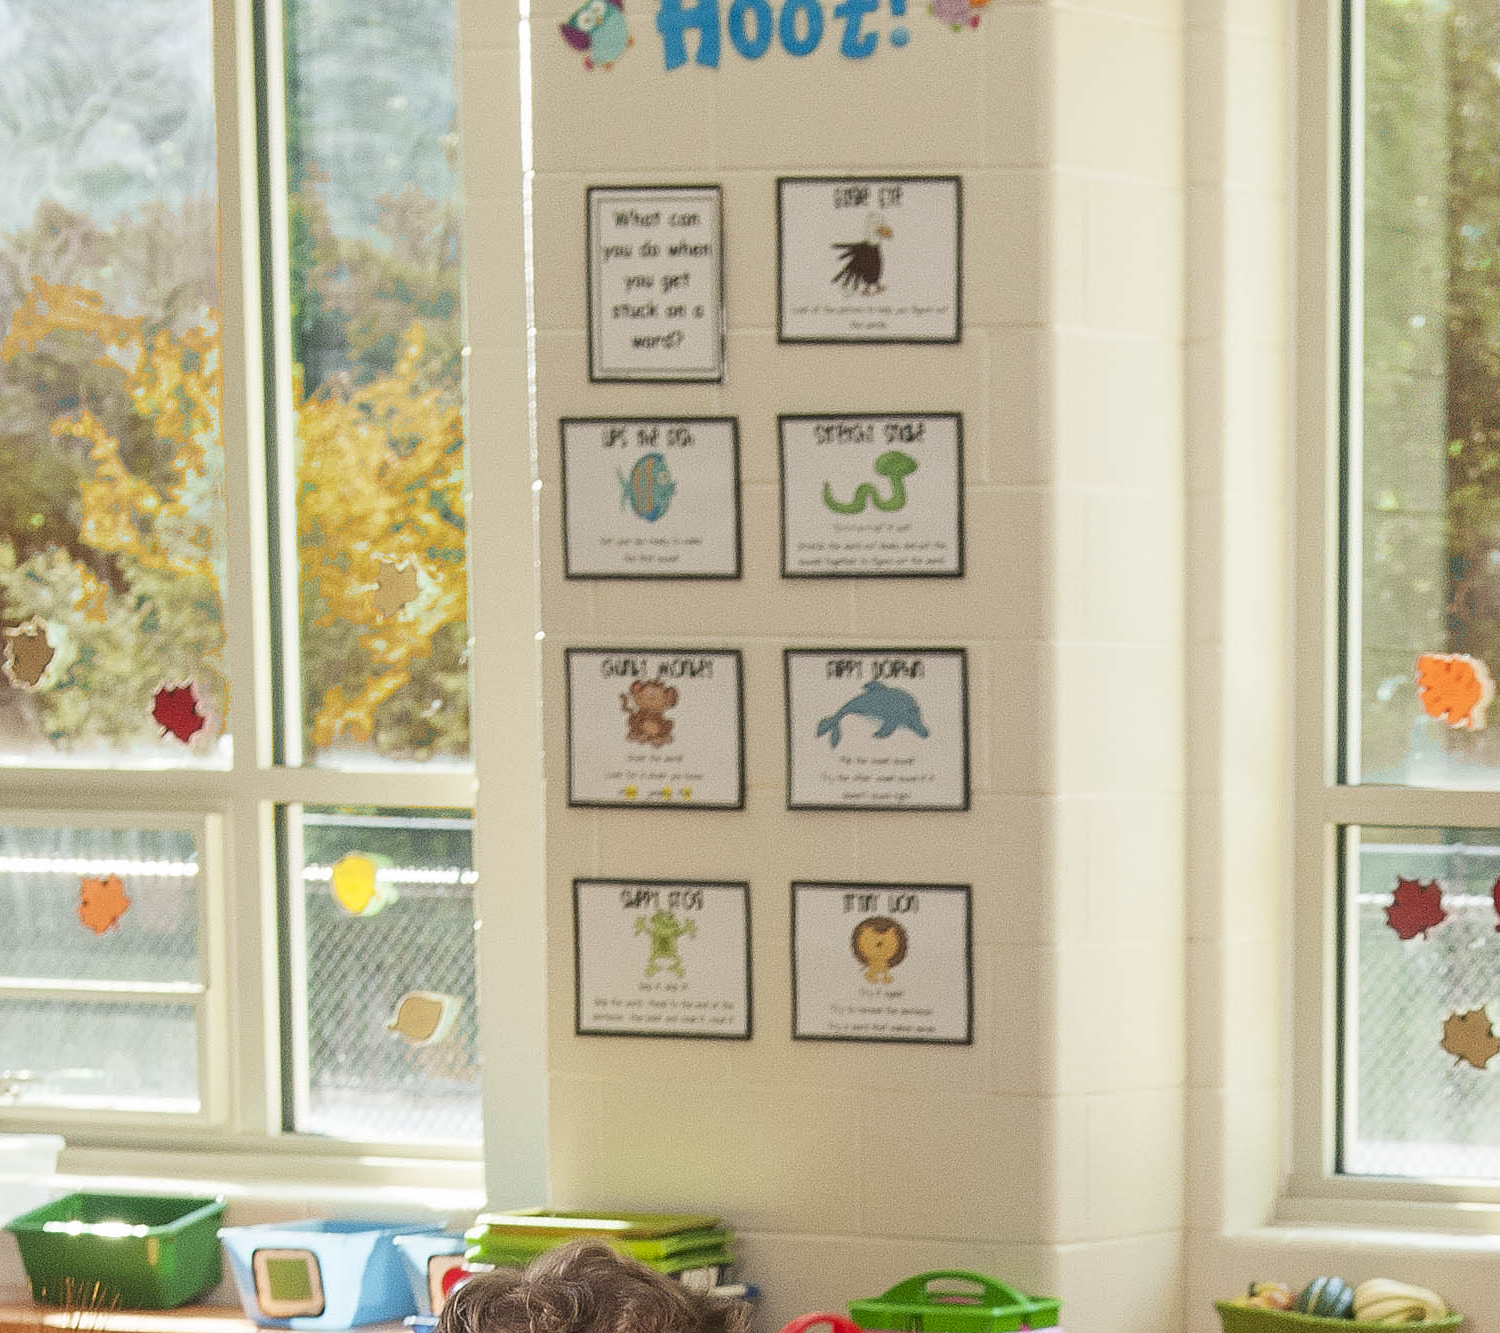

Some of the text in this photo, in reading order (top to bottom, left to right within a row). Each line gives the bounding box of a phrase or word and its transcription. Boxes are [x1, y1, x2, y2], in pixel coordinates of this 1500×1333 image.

[613, 209, 700, 228] What can
[603, 240, 712, 262] you do when
[624, 273, 690, 294] you get
[612, 302, 657, 320] stuck
[664, 305, 686, 319] on
[631, 331, 685, 350] word?
